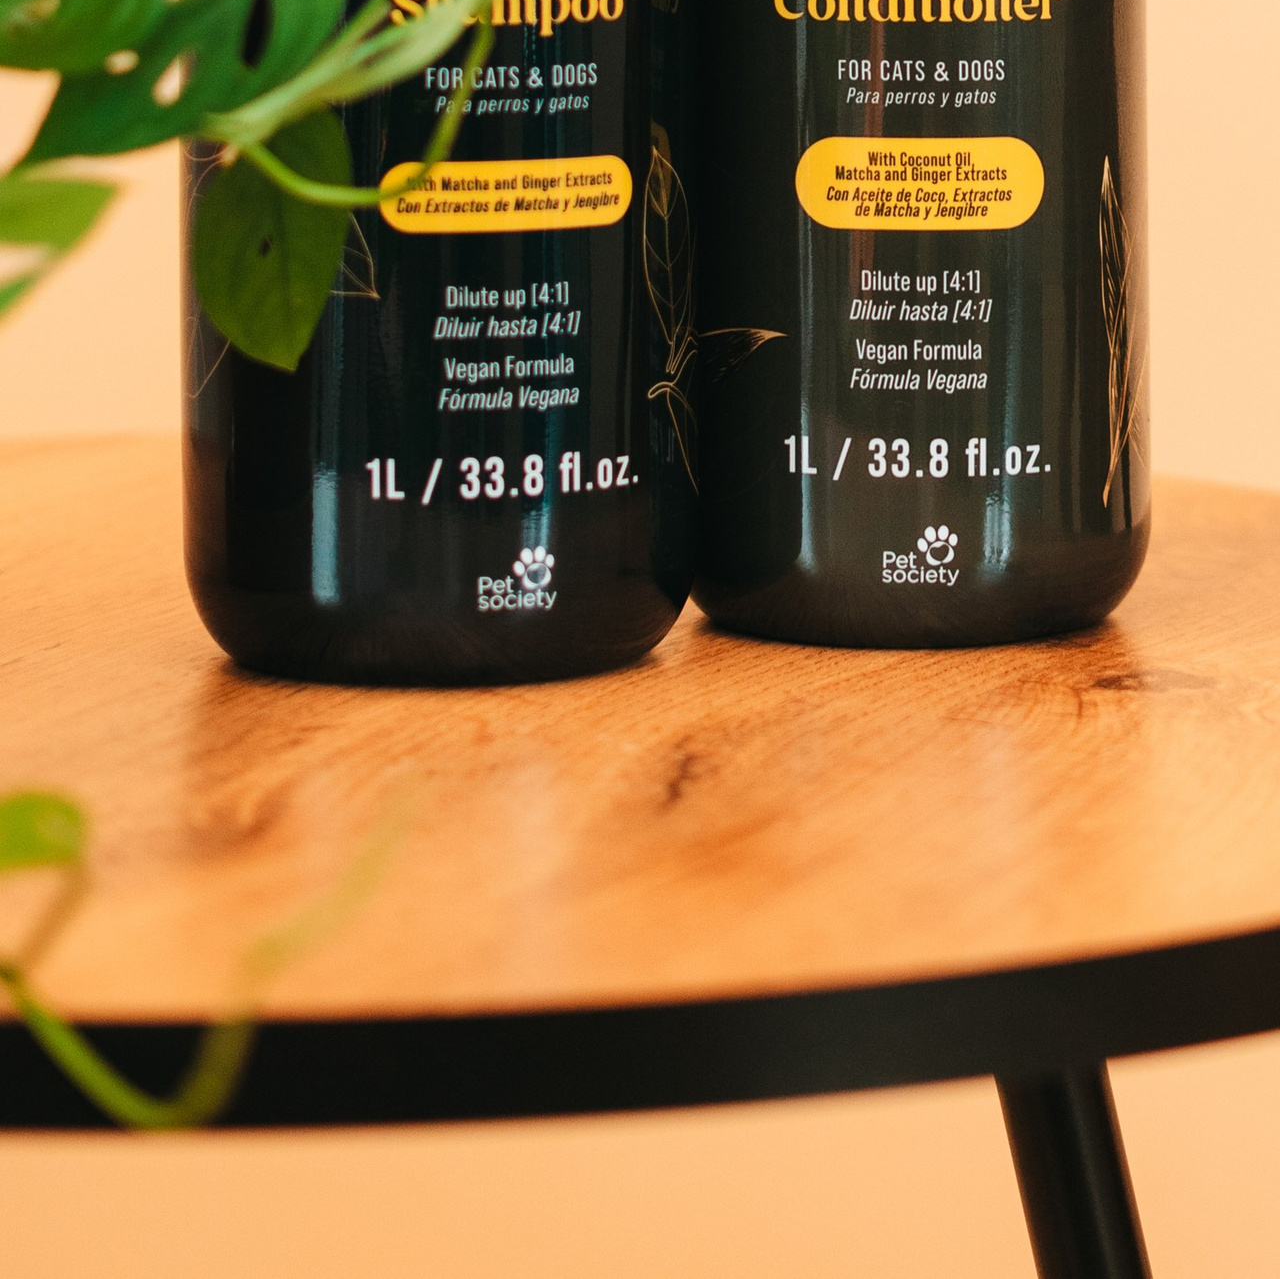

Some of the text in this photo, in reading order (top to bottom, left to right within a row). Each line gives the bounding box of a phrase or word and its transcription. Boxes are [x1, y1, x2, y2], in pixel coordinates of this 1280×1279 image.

[425, 62, 598, 90] FOR CATS & DOGS
[838, 60, 1005, 81] FOR CATS & DOGS
[435, 94, 590, 116] Paa perros y gatos
[846, 88, 997, 107] Para perros y gatos
[868, 152, 974, 166] With Coconut Oil,
[441, 176, 490, 191] Matcha
[494, 175, 517, 190] and
[522, 174, 562, 191] Ginger
[565, 172, 613, 187] Extracts
[836, 166, 1007, 184] Matcha and Ginger Extracts
[397, 191, 620, 213] Con Extractos de Matcha y Jengibre
[827, 186, 1012, 203] Con Aceite de Coco, Extractos
[855, 202, 988, 220] de Matcha y Jengibre
[861, 270, 980, 295] Dilute up [4:1]
[446, 282, 569, 310] Dilute up [4:1]
[849, 299, 992, 323] Diluir hasta [4:1]
[433, 310, 581, 339] Diluir hasta [4:1]
[856, 339, 982, 363] Vegan Formula
[444, 353, 575, 384] Vegan Formula
[850, 368, 987, 394] Fórmula Vegana
[438, 385, 580, 412] Fórmula Vegana
[784, 436, 1051, 481] 1L / 33.8 fl.oz.
[366, 457, 405, 500] 1L
[421, 457, 443, 505] /
[459, 453, 545, 500] 33.8
[882, 551, 916, 569] Pet
[478, 576, 513, 595] Pet
[882, 566, 959, 585] society
[478, 589, 557, 610] society
